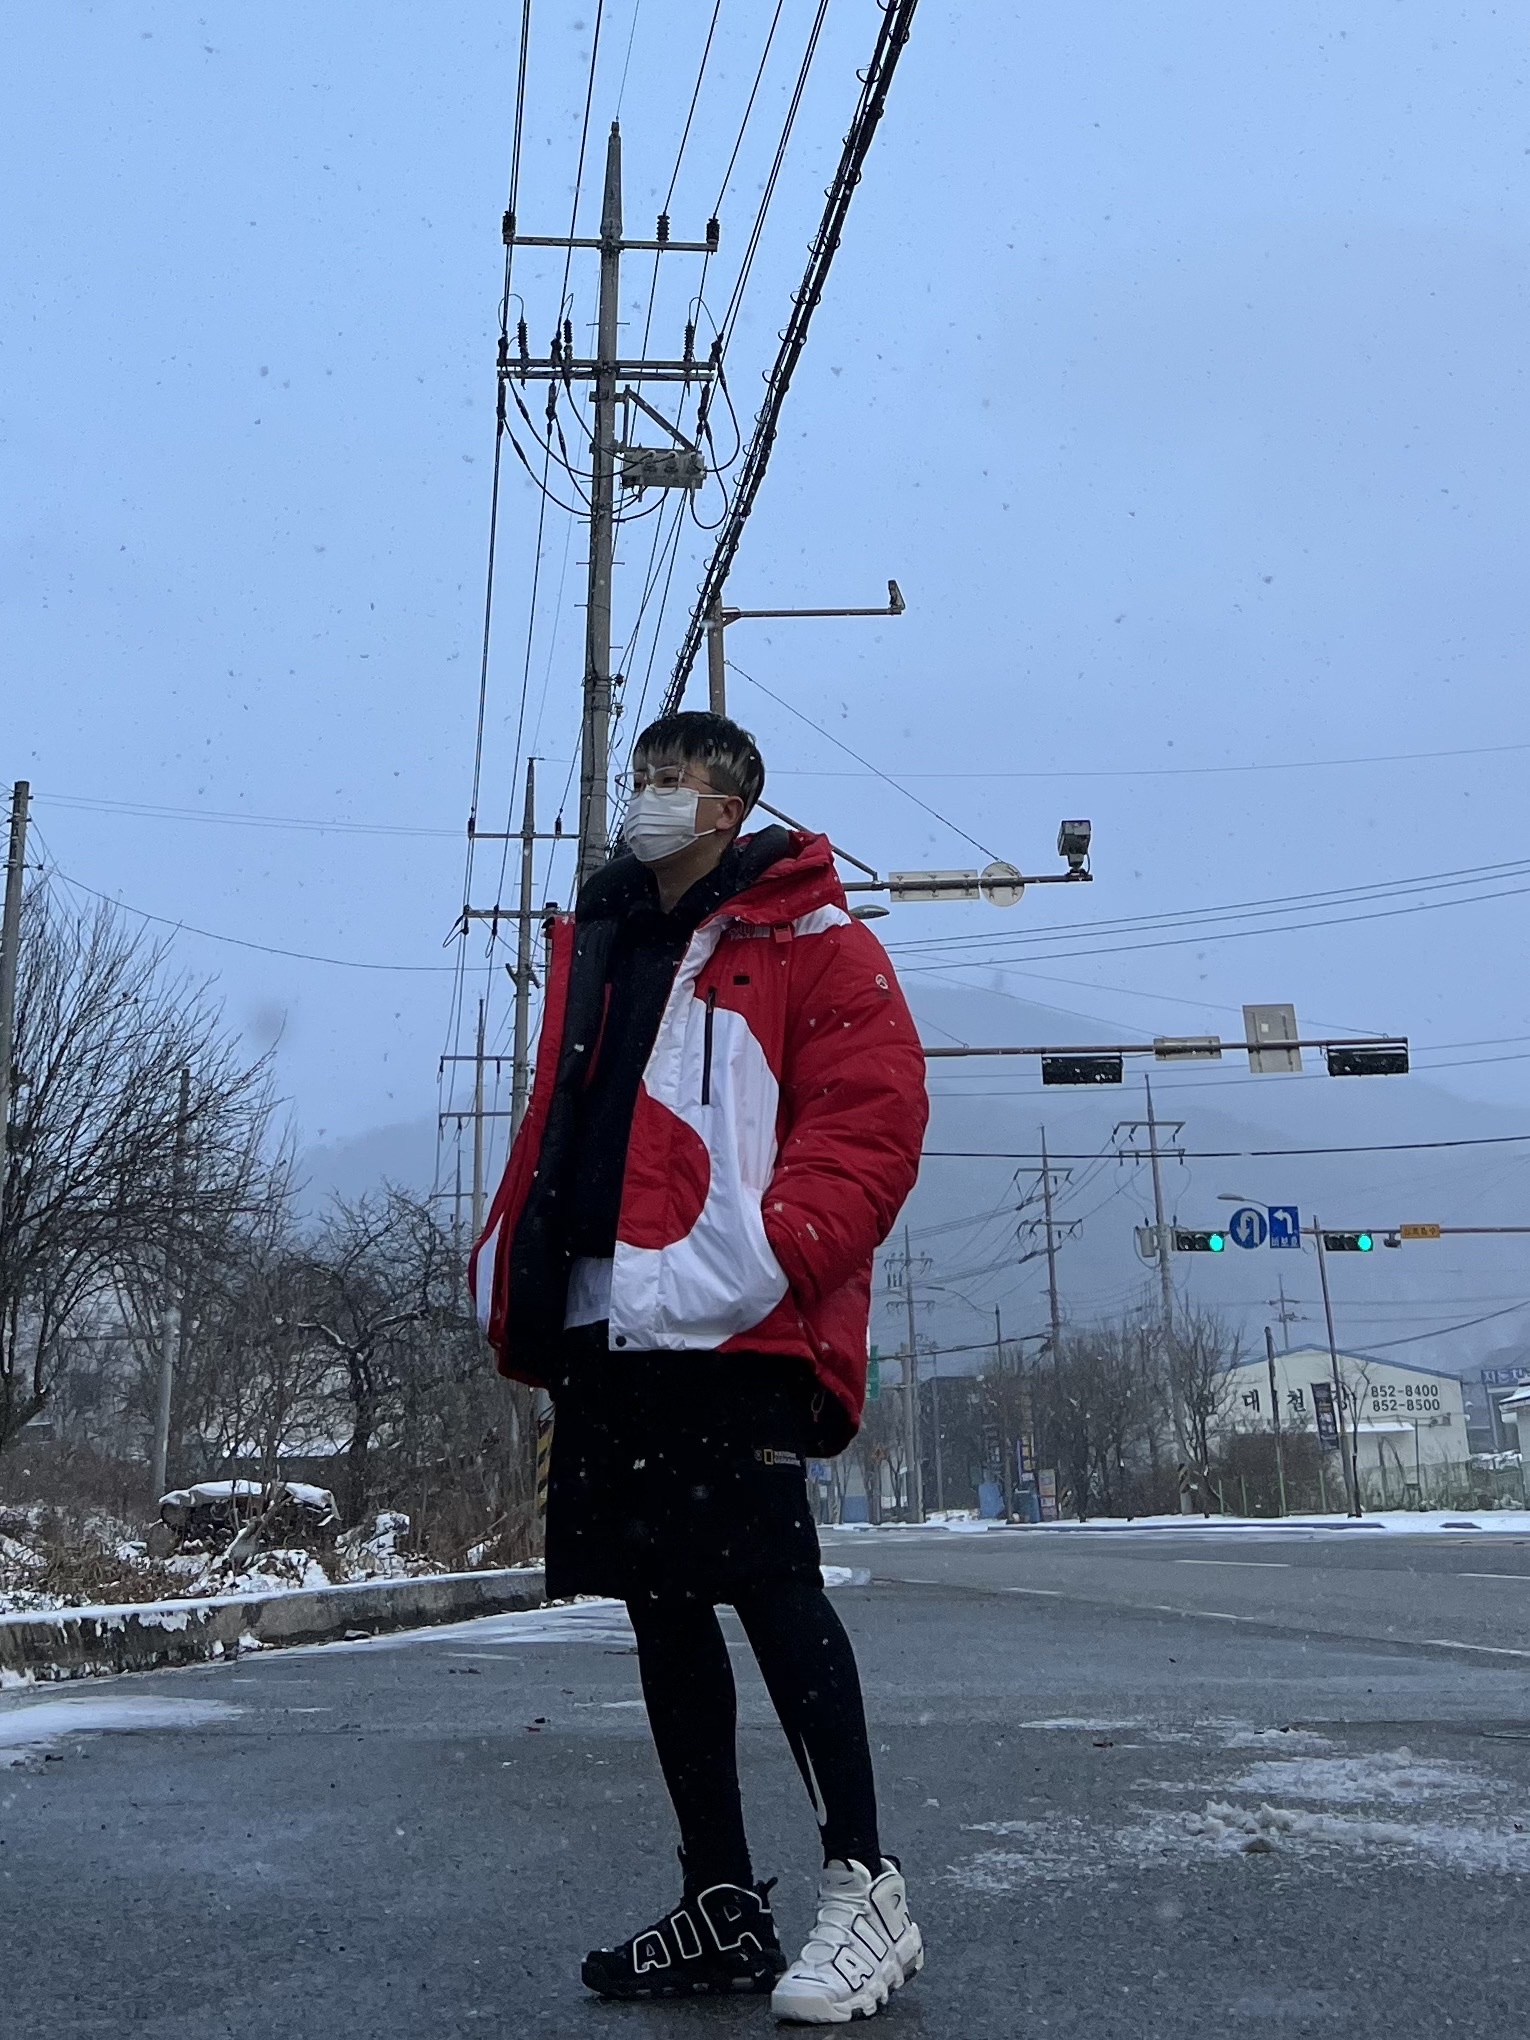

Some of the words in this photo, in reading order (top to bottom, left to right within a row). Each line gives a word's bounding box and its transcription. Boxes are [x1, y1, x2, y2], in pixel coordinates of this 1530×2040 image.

[1371, 1384, 1439, 1398] 852-8400
[1372, 1398, 1440, 1412] 852-8500
[632, 1883, 772, 1974] AIR
